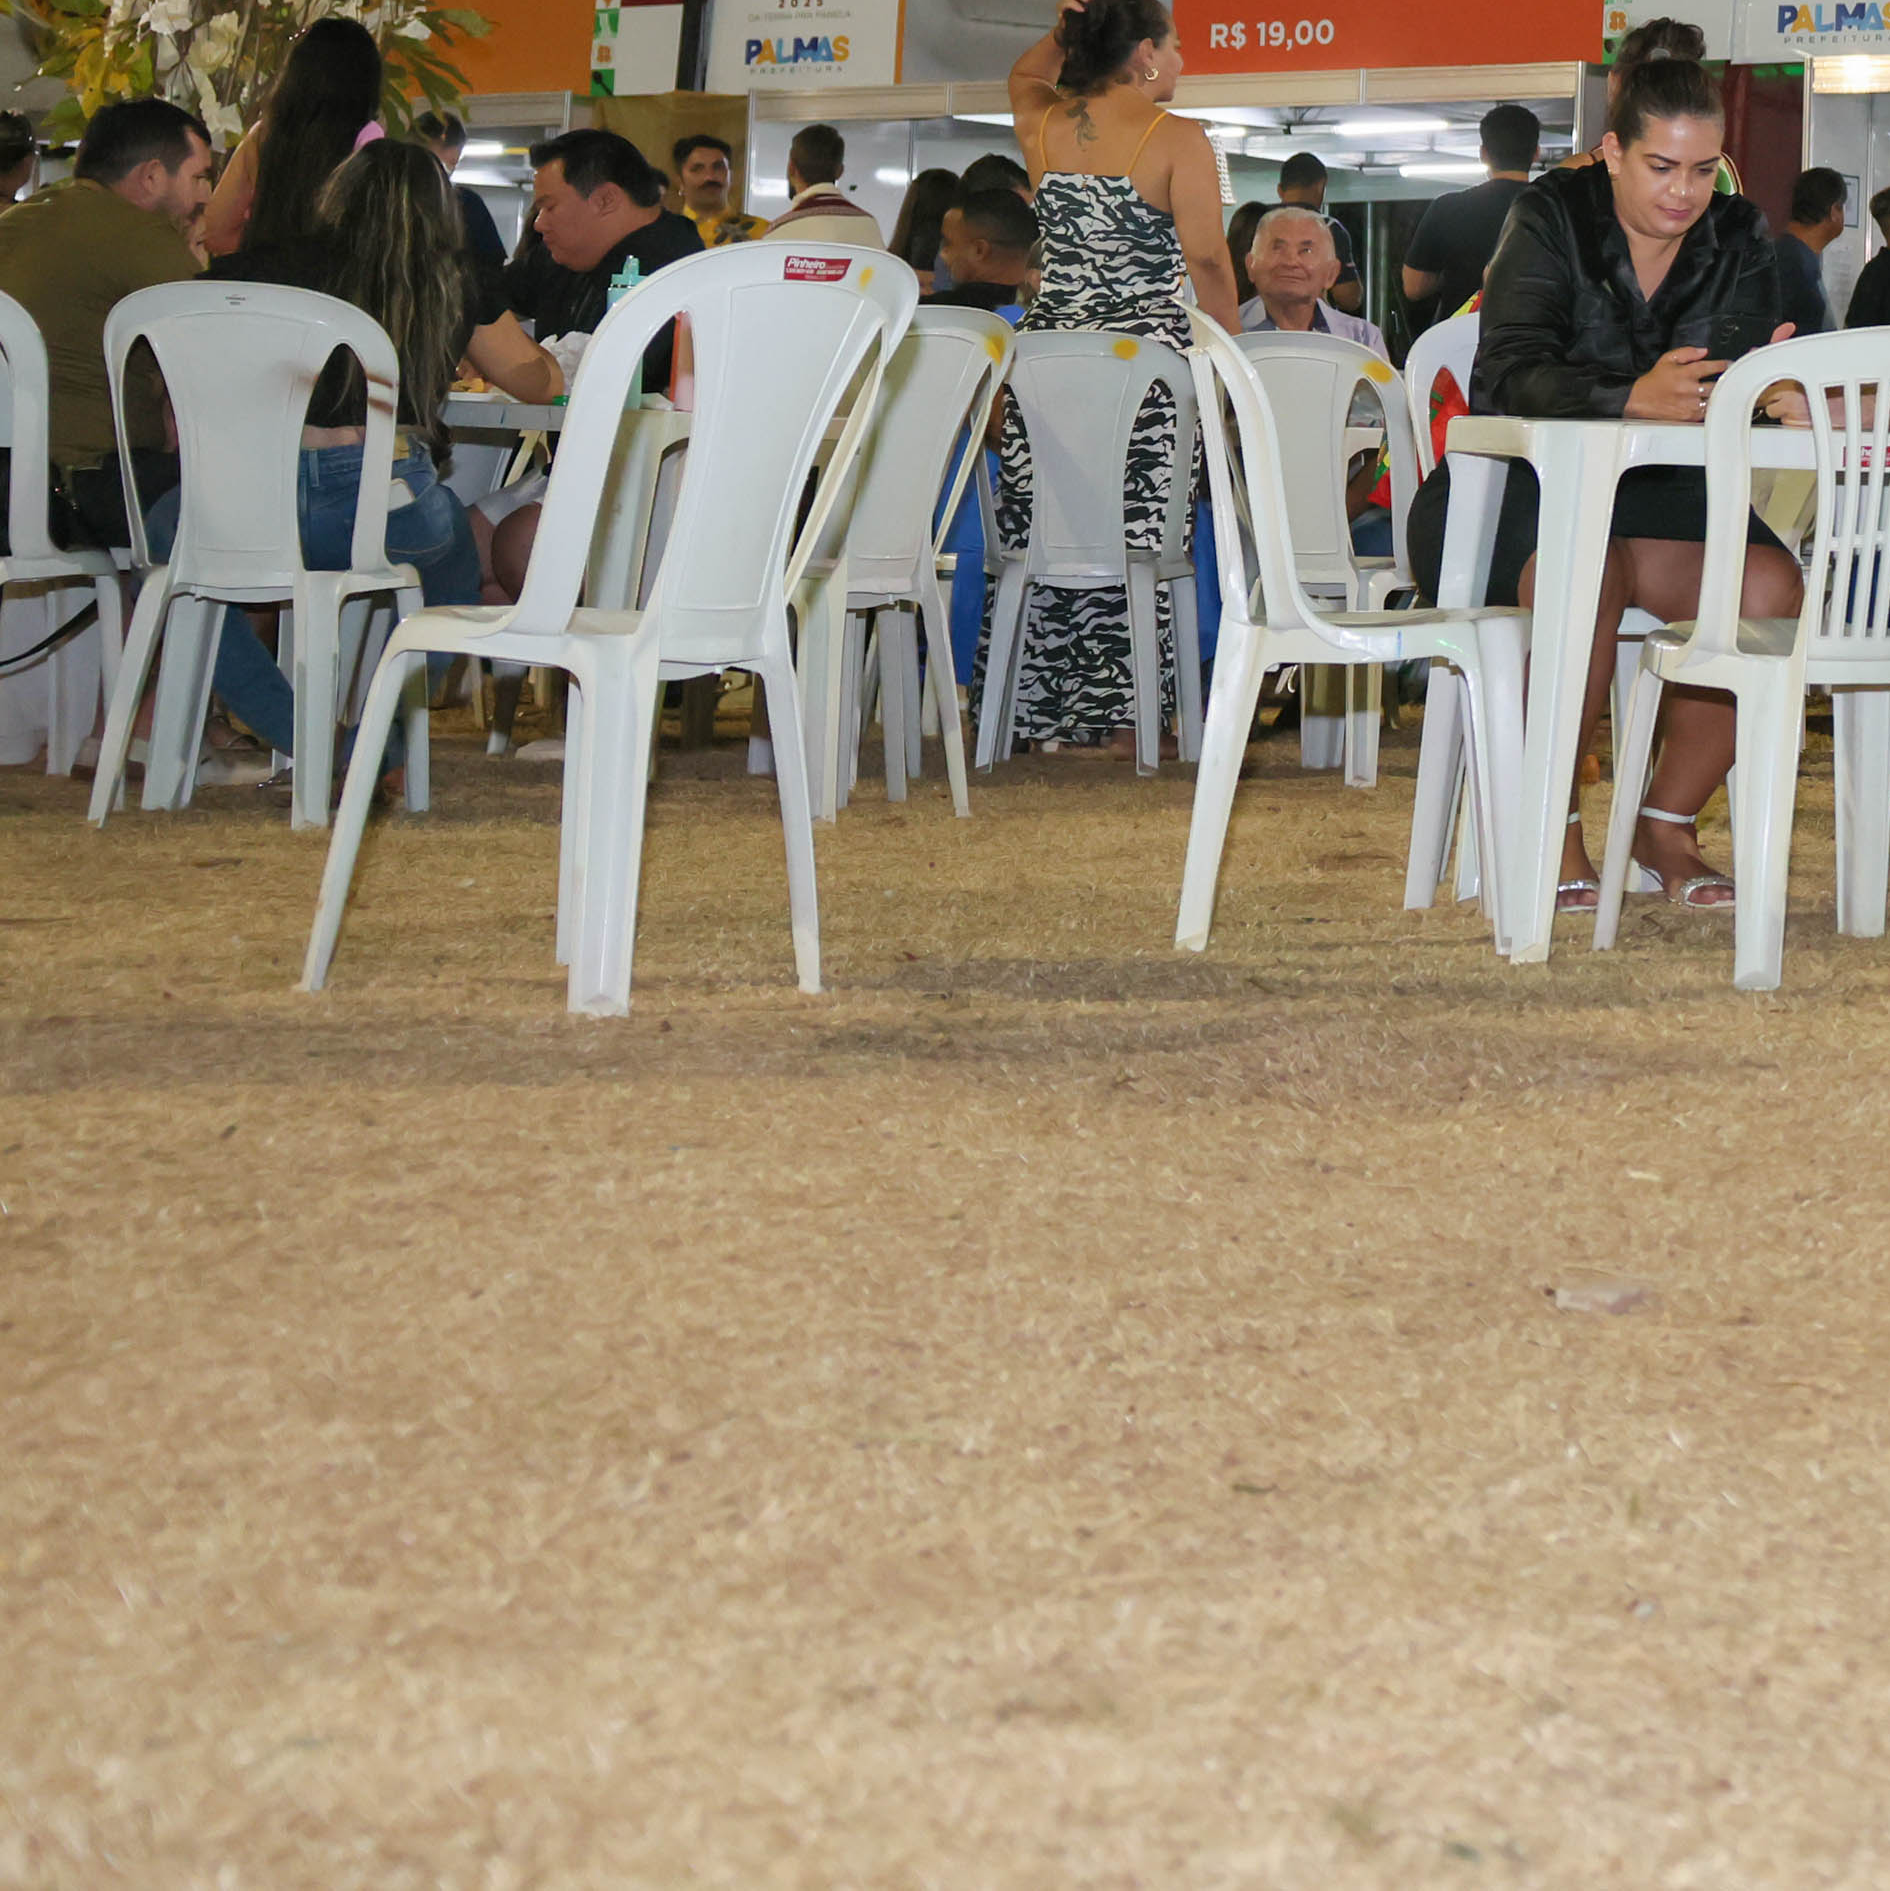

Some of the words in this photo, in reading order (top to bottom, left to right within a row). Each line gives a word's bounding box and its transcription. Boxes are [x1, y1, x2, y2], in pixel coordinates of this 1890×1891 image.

[744, 35, 849, 65] PALMAS
[1209, 21, 1247, 50] R$
[1256, 18, 1335, 52] 19,00
